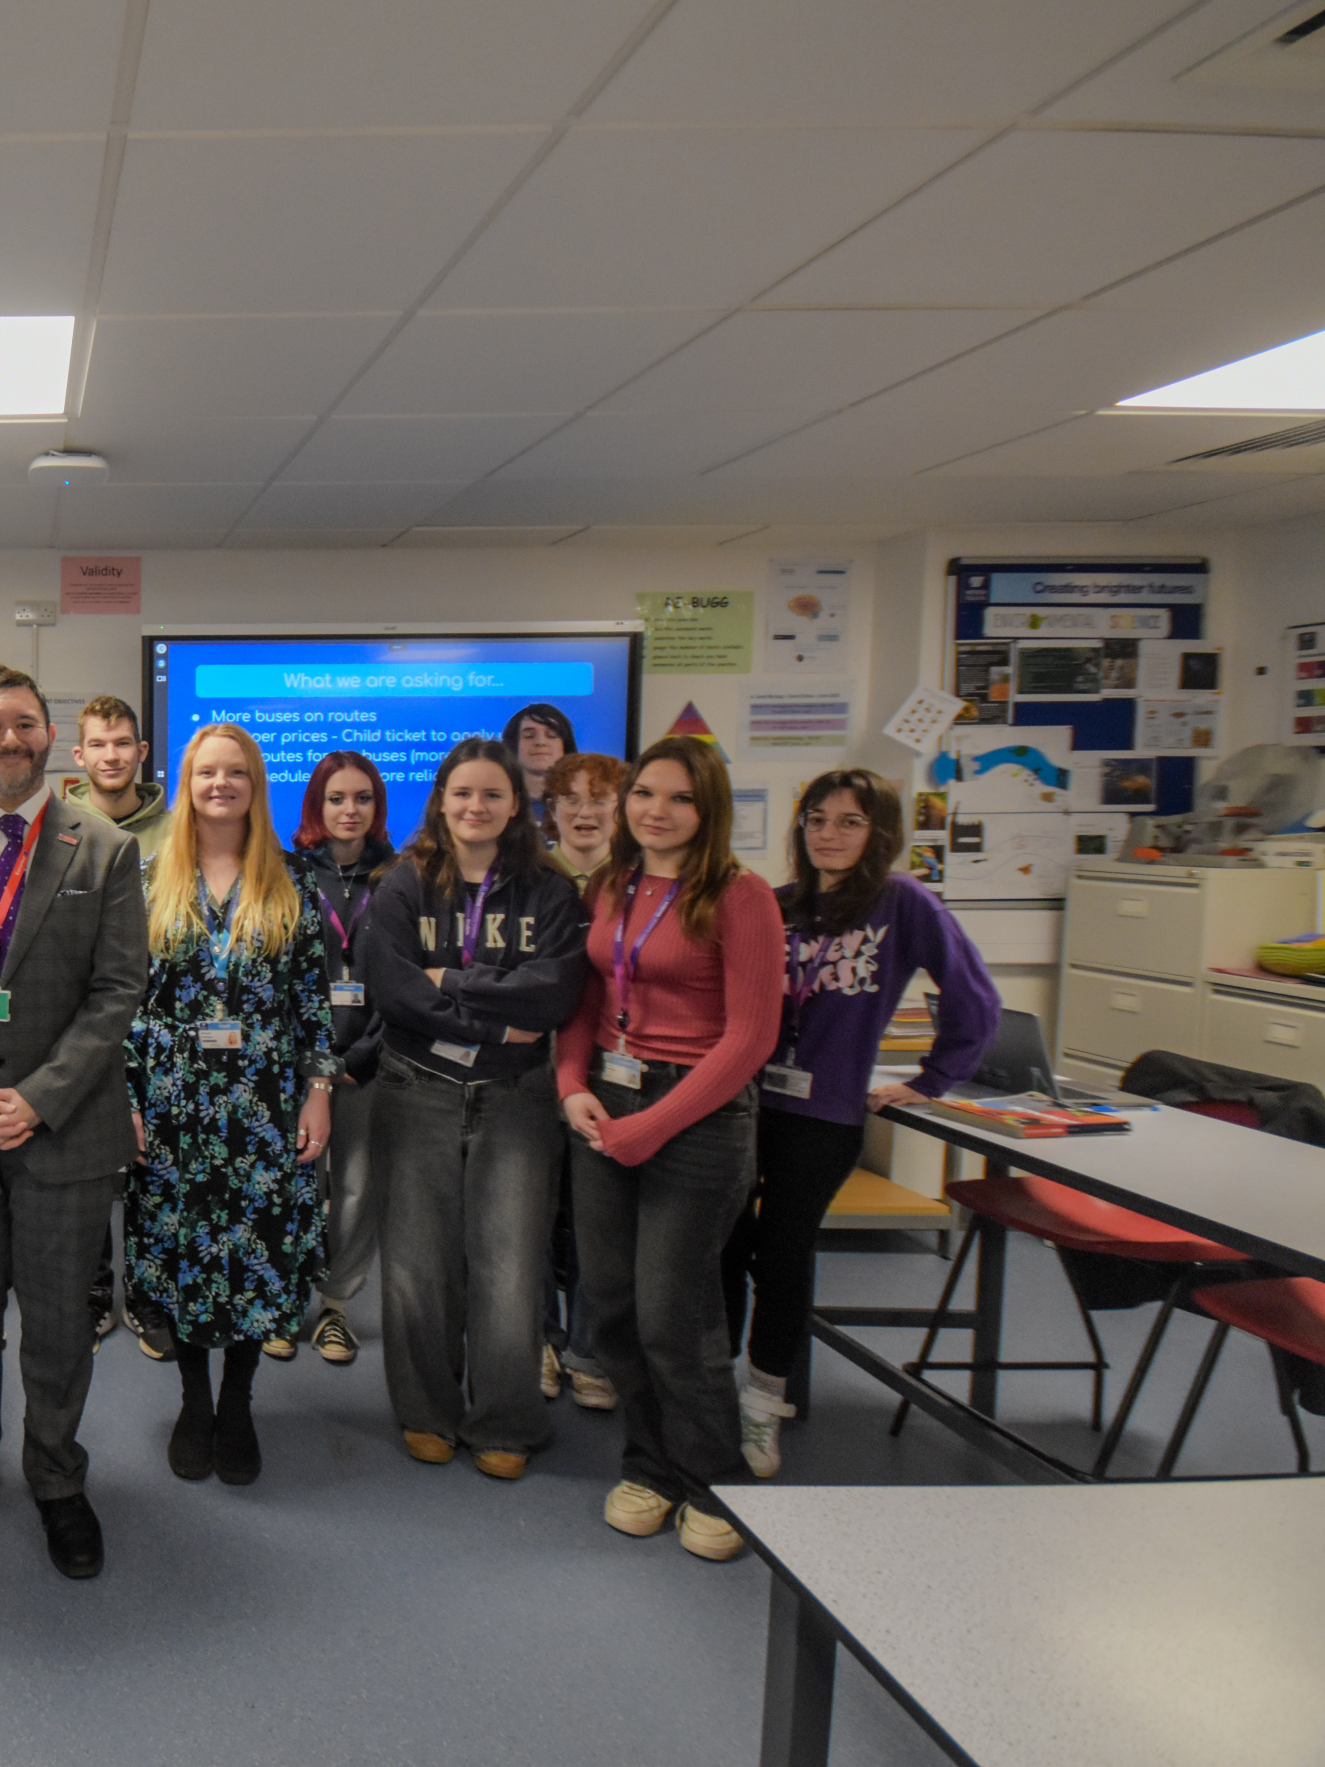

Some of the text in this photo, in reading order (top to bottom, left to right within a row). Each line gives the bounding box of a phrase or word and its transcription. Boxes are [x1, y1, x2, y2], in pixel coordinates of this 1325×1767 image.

[80, 565, 123, 578] Validity
[283, 671, 504, 691] What we are asking for...
[212, 709, 377, 723] More buses on routes
[281, 729, 328, 746] prices
[342, 728, 381, 742] Child
[386, 729, 427, 742] ticket
[431, 730, 447, 742] to
[261, 750, 303, 762] outes
[362, 749, 407, 762] buses
[419, 912, 537, 952] NIKE
